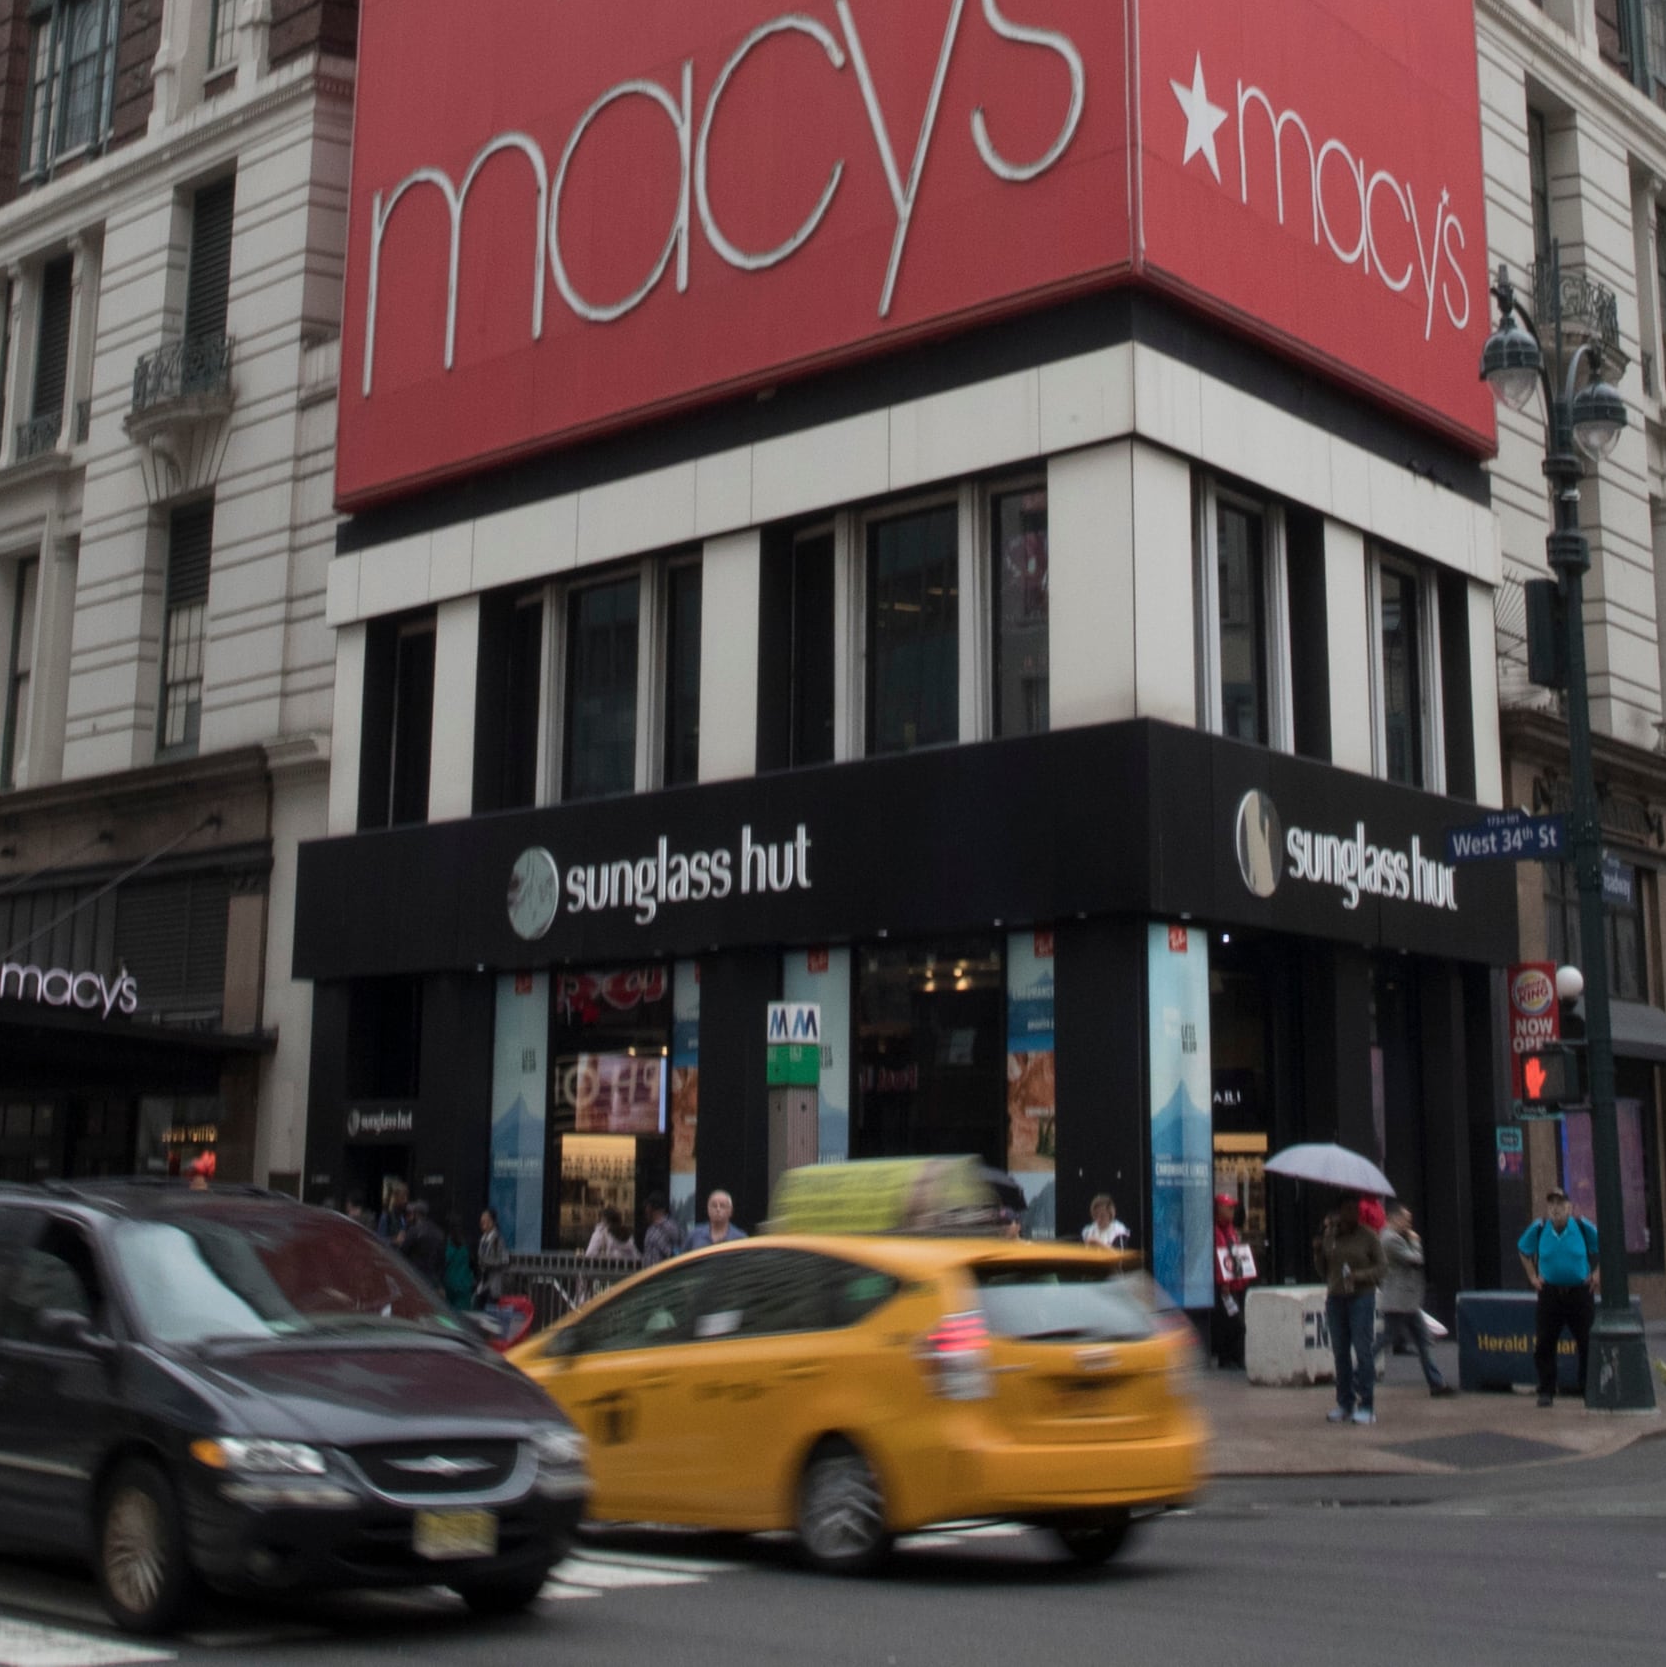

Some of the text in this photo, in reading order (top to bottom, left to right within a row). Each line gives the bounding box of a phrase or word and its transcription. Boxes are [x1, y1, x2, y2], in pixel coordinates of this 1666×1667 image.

[1237, 77, 1470, 340] macy's
[1286, 821, 1458, 912] sunglass hut
[1453, 832, 1498, 858] West
[1538, 824, 1558, 849] St
[565, 823, 812, 924] sunglass hut
[0, 960, 138, 1021] macy's
[1515, 1018, 1553, 1035] NOW
[1476, 1333, 1528, 1354] Herald
